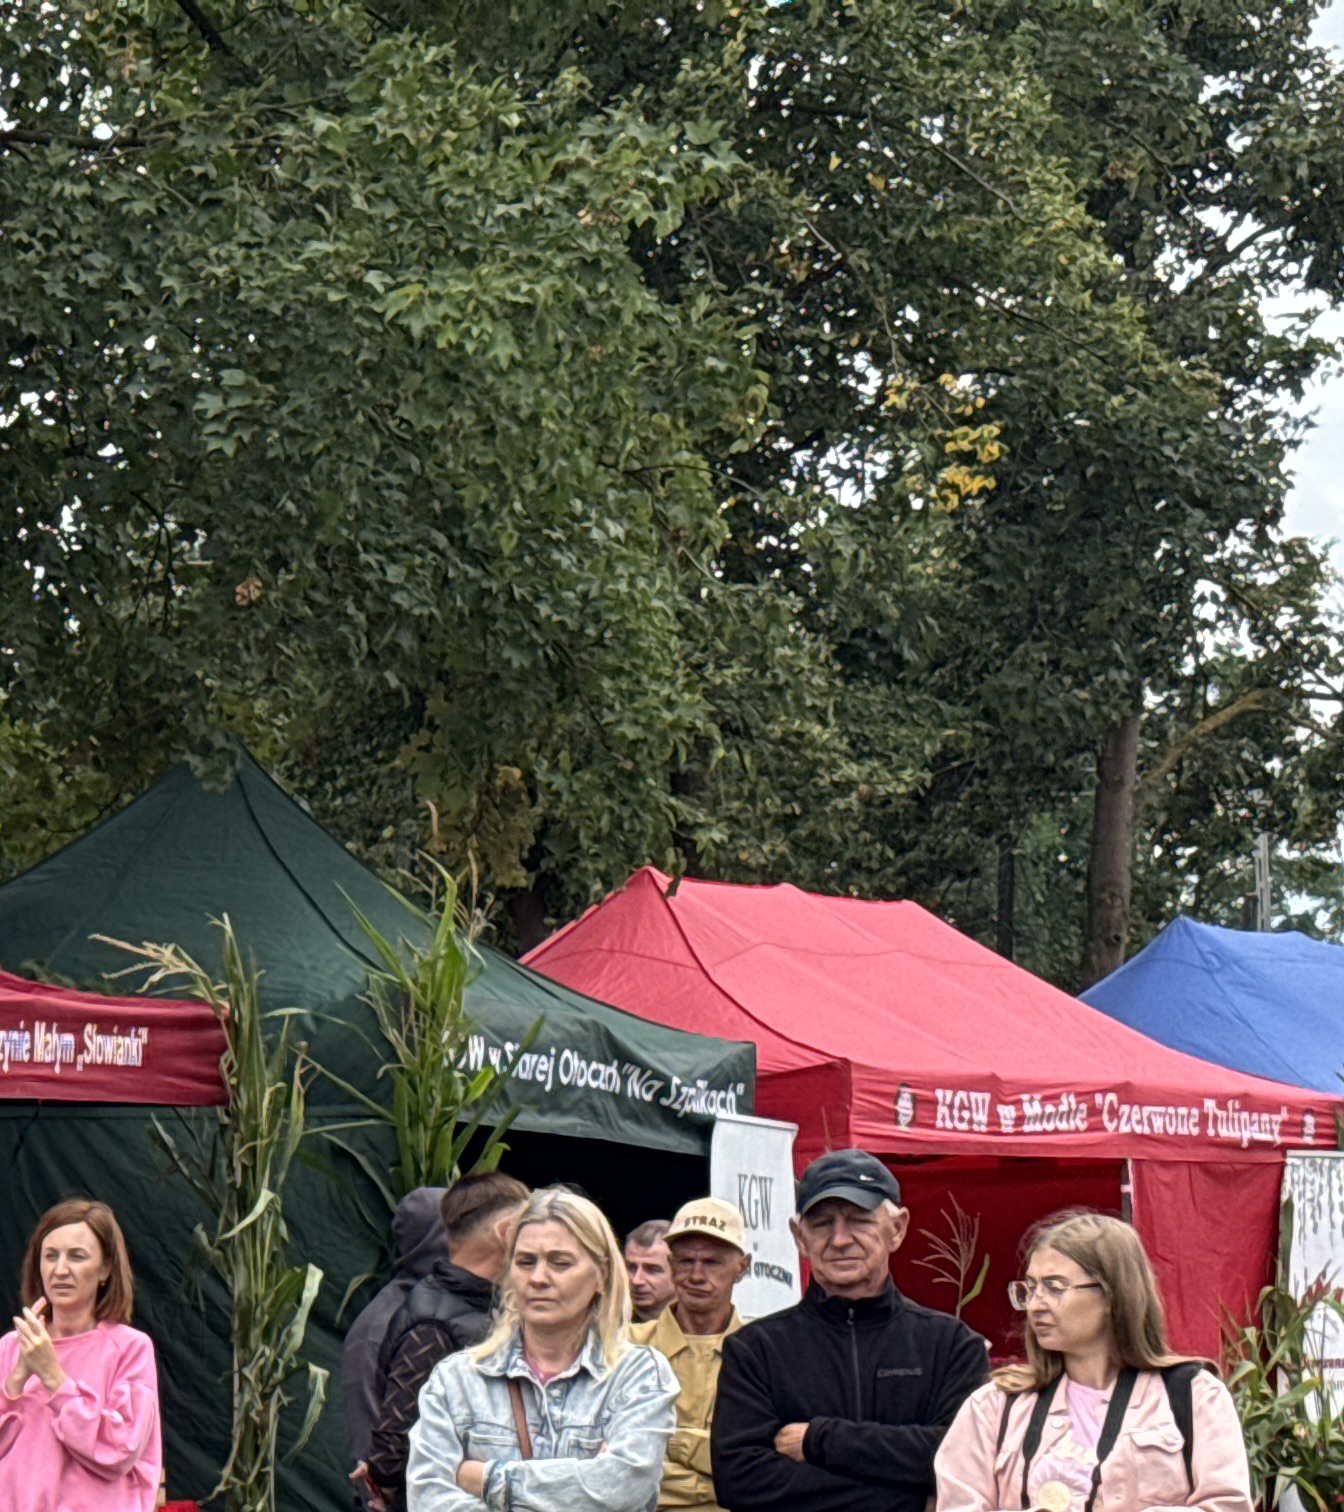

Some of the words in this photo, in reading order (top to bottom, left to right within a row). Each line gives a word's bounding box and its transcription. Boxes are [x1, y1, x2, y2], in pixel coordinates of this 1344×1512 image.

[33, 1020, 76, 1074] Małym
[935, 1088, 991, 1133] KGW
[996, 1104, 1016, 1133] w
[1020, 1092, 1088, 1132] Modle
[737, 1173, 774, 1231] KGW
